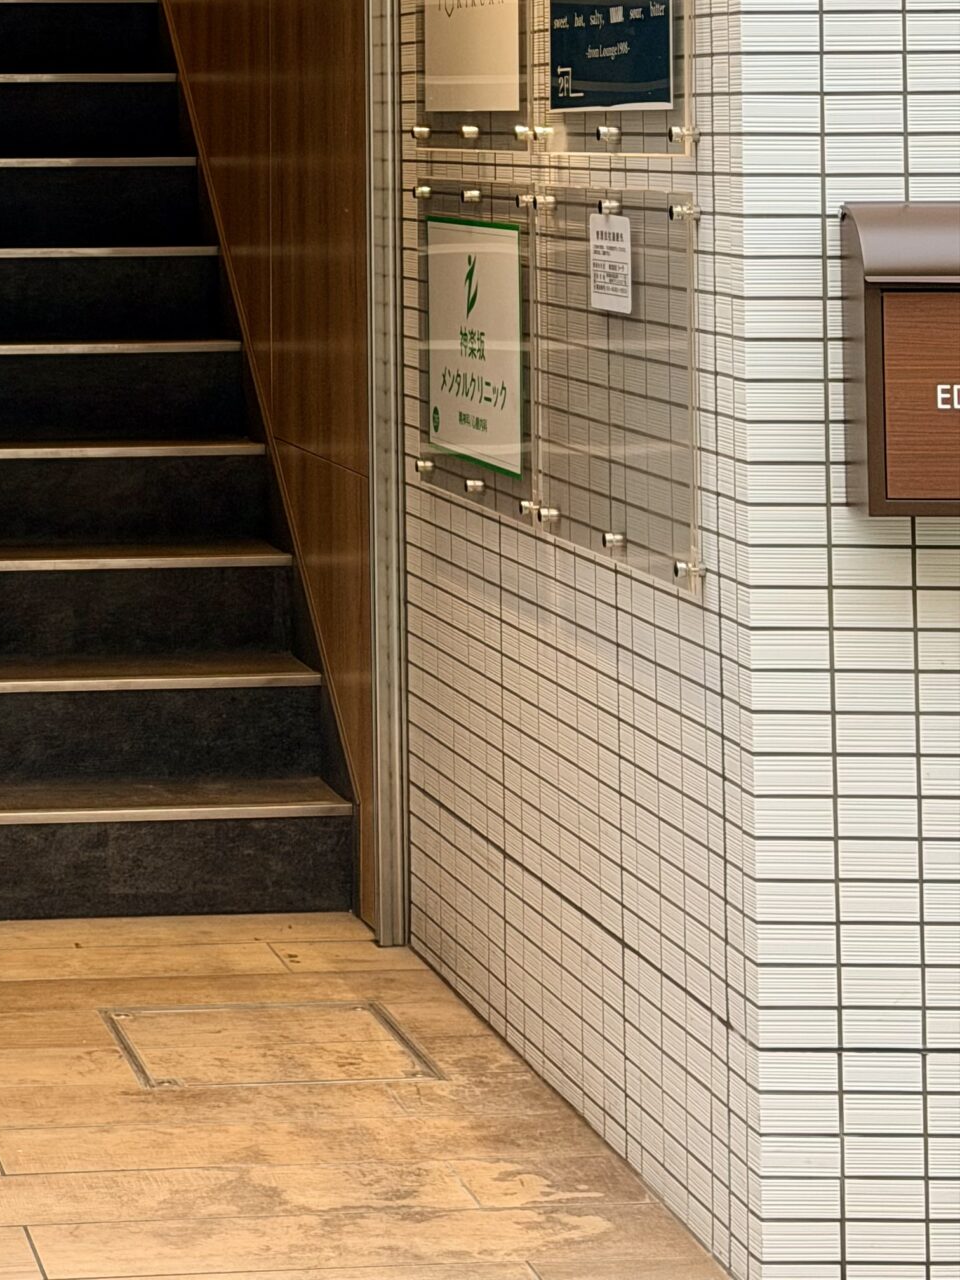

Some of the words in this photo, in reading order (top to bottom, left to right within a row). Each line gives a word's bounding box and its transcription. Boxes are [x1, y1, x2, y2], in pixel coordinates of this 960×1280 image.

[459, 326, 486, 361] 神楽坂
[440, 366, 507, 411] メンタルクリニック
